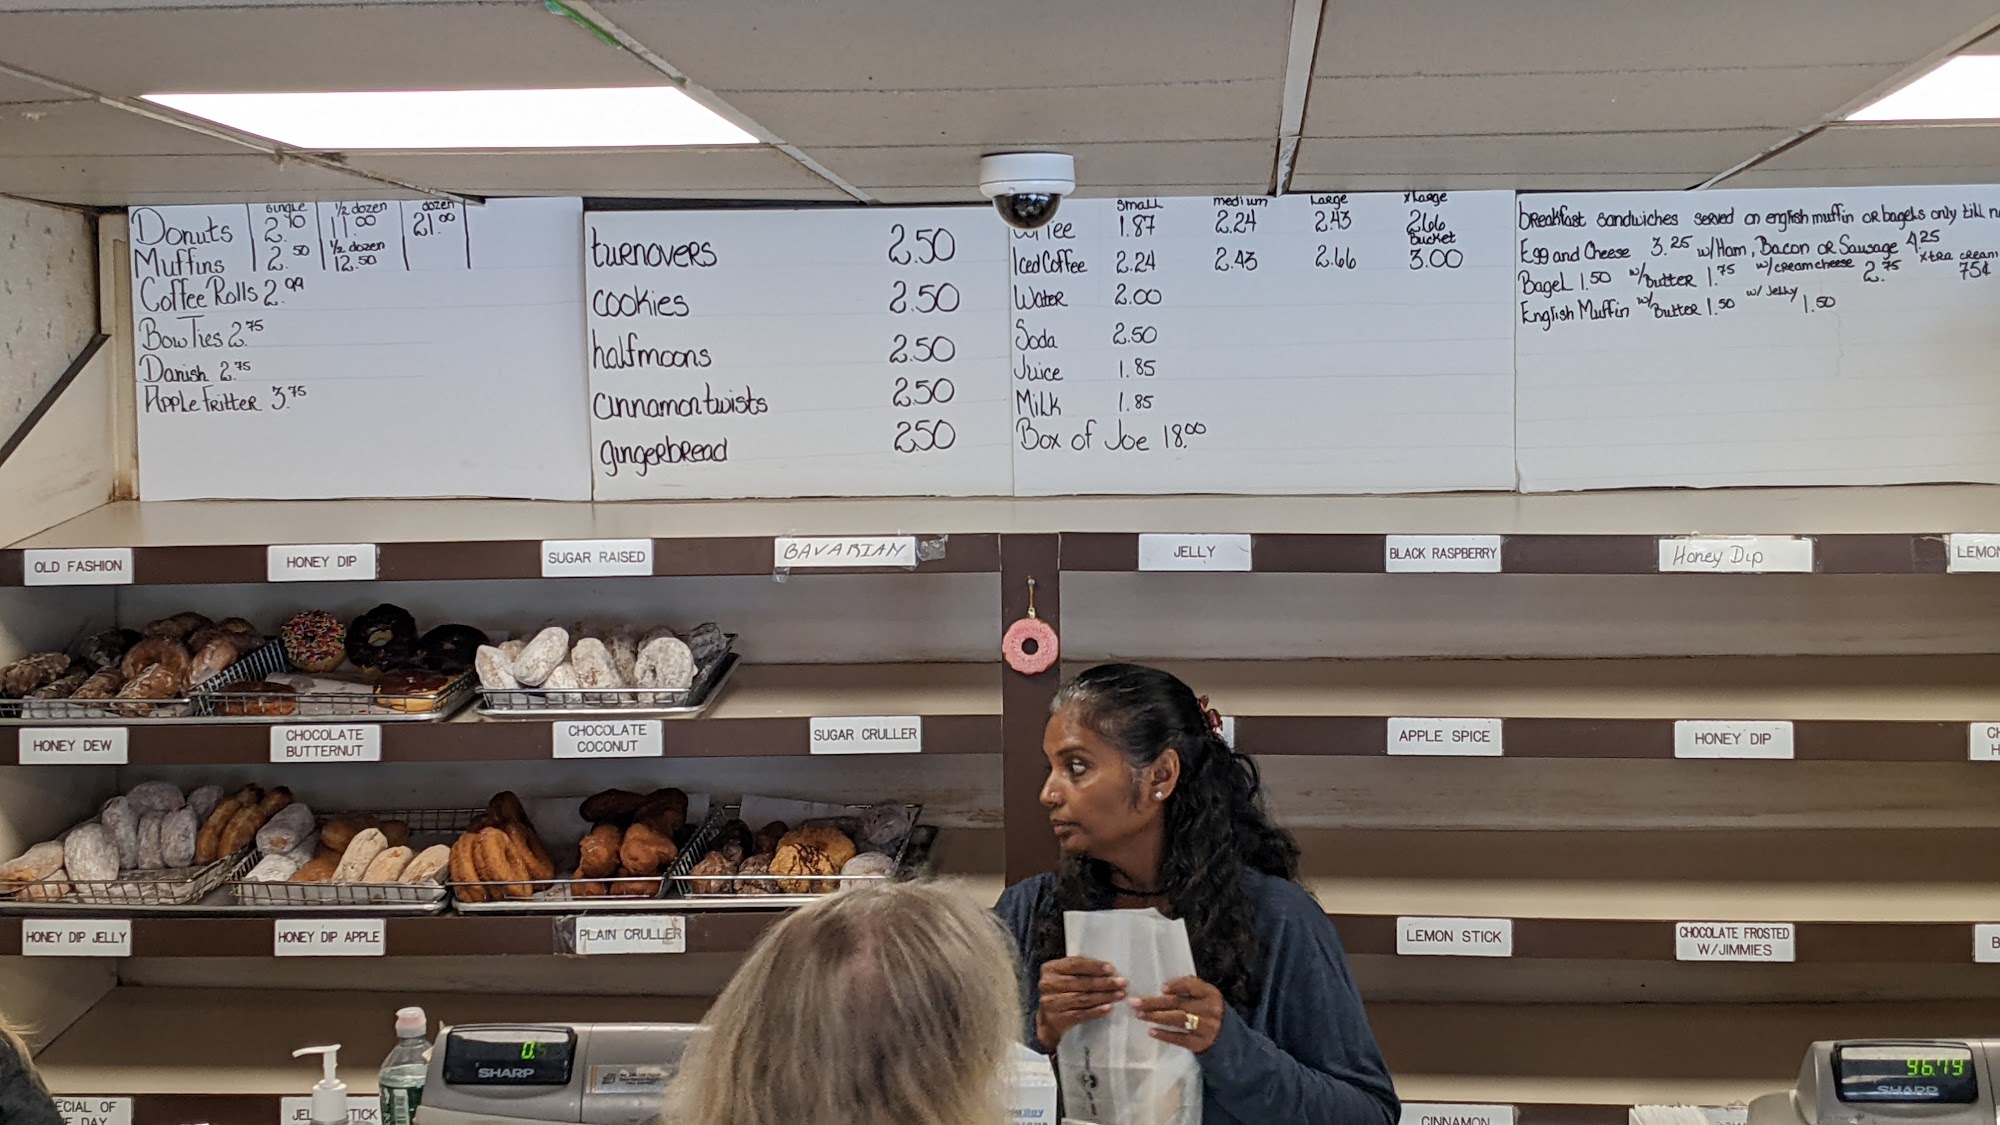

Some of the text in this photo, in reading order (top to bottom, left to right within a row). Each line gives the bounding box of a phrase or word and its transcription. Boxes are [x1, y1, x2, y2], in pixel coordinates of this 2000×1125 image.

[351, 202, 388, 215] dozen
[421, 201, 455, 211] dozen
[1116, 198, 1165, 212] small
[1213, 195, 1269, 208] medium
[1119, 213, 1156, 238] 1.87
[1214, 208, 1258, 235] 2.24
[1314, 209, 1352, 233] 2.43
[1518, 200, 1587, 231] breakfast
[1595, 208, 1679, 228] sandwiches
[1693, 206, 1735, 227] served
[1743, 212, 1761, 226] on
[1764, 208, 1810, 233] english
[1811, 202, 1855, 226] muffin
[1880, 203, 1927, 232] bagels
[1930, 204, 1958, 226] only
[1961, 201, 1986, 220] till
[130, 207, 234, 246] Donuts
[330, 213, 377, 240] 11.00
[412, 211, 456, 237] 21.00
[348, 240, 386, 253] dozen
[590, 223, 956, 269] turnovers 2.50
[1520, 237, 1550, 266] Egg
[1552, 245, 1581, 264] and
[1583, 239, 1632, 261] Cheese
[1650, 234, 1694, 257] 3.25
[1751, 234, 1811, 259] Bacon
[1838, 233, 1900, 261] Sausage
[1905, 228, 1942, 255] 4.25
[134, 244, 311, 280] Muffins 2.50
[333, 253, 378, 273] 12.50
[1012, 244, 1464, 277] Iced Coffee 2.24 2.43 2.66 3.00
[1580, 270, 1612, 291] 1.50
[1706, 262, 1736, 288] 1.75
[1862, 259, 1903, 283] 2.75
[139, 275, 209, 313] Coffee
[204, 274, 259, 307] Rolls
[592, 280, 961, 318] cookies 2.50
[1013, 282, 1163, 311] Water 2.00
[1519, 299, 1575, 332] English
[1576, 298, 1630, 321] Muffin
[1706, 297, 1736, 316] 1.50
[1802, 293, 1837, 314] 1.50
[138, 314, 265, 351] Bow Ties 2.75
[1014, 317, 1158, 352] Soda 2.50
[888, 333, 956, 364] 2.50
[138, 353, 252, 383] Danish 2.75
[1012, 355, 1157, 382] Juice 1.85
[144, 384, 308, 414] Apple Fritter 3.75
[892, 376, 956, 408] 2.50
[1015, 387, 1155, 419] Milk 1.85
[1015, 416, 1207, 452] Box of Joe 18.00
[599, 434, 728, 478] gingerbread
[548, 550, 646, 564] SUGAR RAISED
[784, 542, 906, 560] BAVARIAN
[1173, 545, 1216, 559] JELLY
[1389, 547, 1497, 560] BLACK RASPBERRY
[1672, 544, 1764, 569] Honey Dip
[34, 559, 123, 574] OLD FASHION
[286, 555, 358, 569] HONEY DIP
[285, 728, 364, 742] CHOCOLATE
[568, 723, 648, 737] CHOCOLATE
[814, 727, 917, 742] SUGAR CRULLER
[1398, 729, 1491, 743] APPLE SPICE
[33, 739, 113, 752] HONEY DEW
[576, 739, 639, 753] COCONUT
[1694, 732, 1772, 746] HONEY DIP
[285, 744, 364, 758] BUTTERNUT
[26, 931, 126, 944] HONEY DIP JELLY
[278, 930, 379, 944] HONEY DIP APPLE
[579, 927, 682, 942] PLAIN CRULLER
[1406, 929, 1502, 944] LEMON STICK
[1679, 926, 1790, 940] CHOCOLATE FROSTED
[1696, 942, 1773, 957] W/JIMMIES
[478, 1068, 535, 1079] SHARP
[99, 1101, 117, 1113] OF
